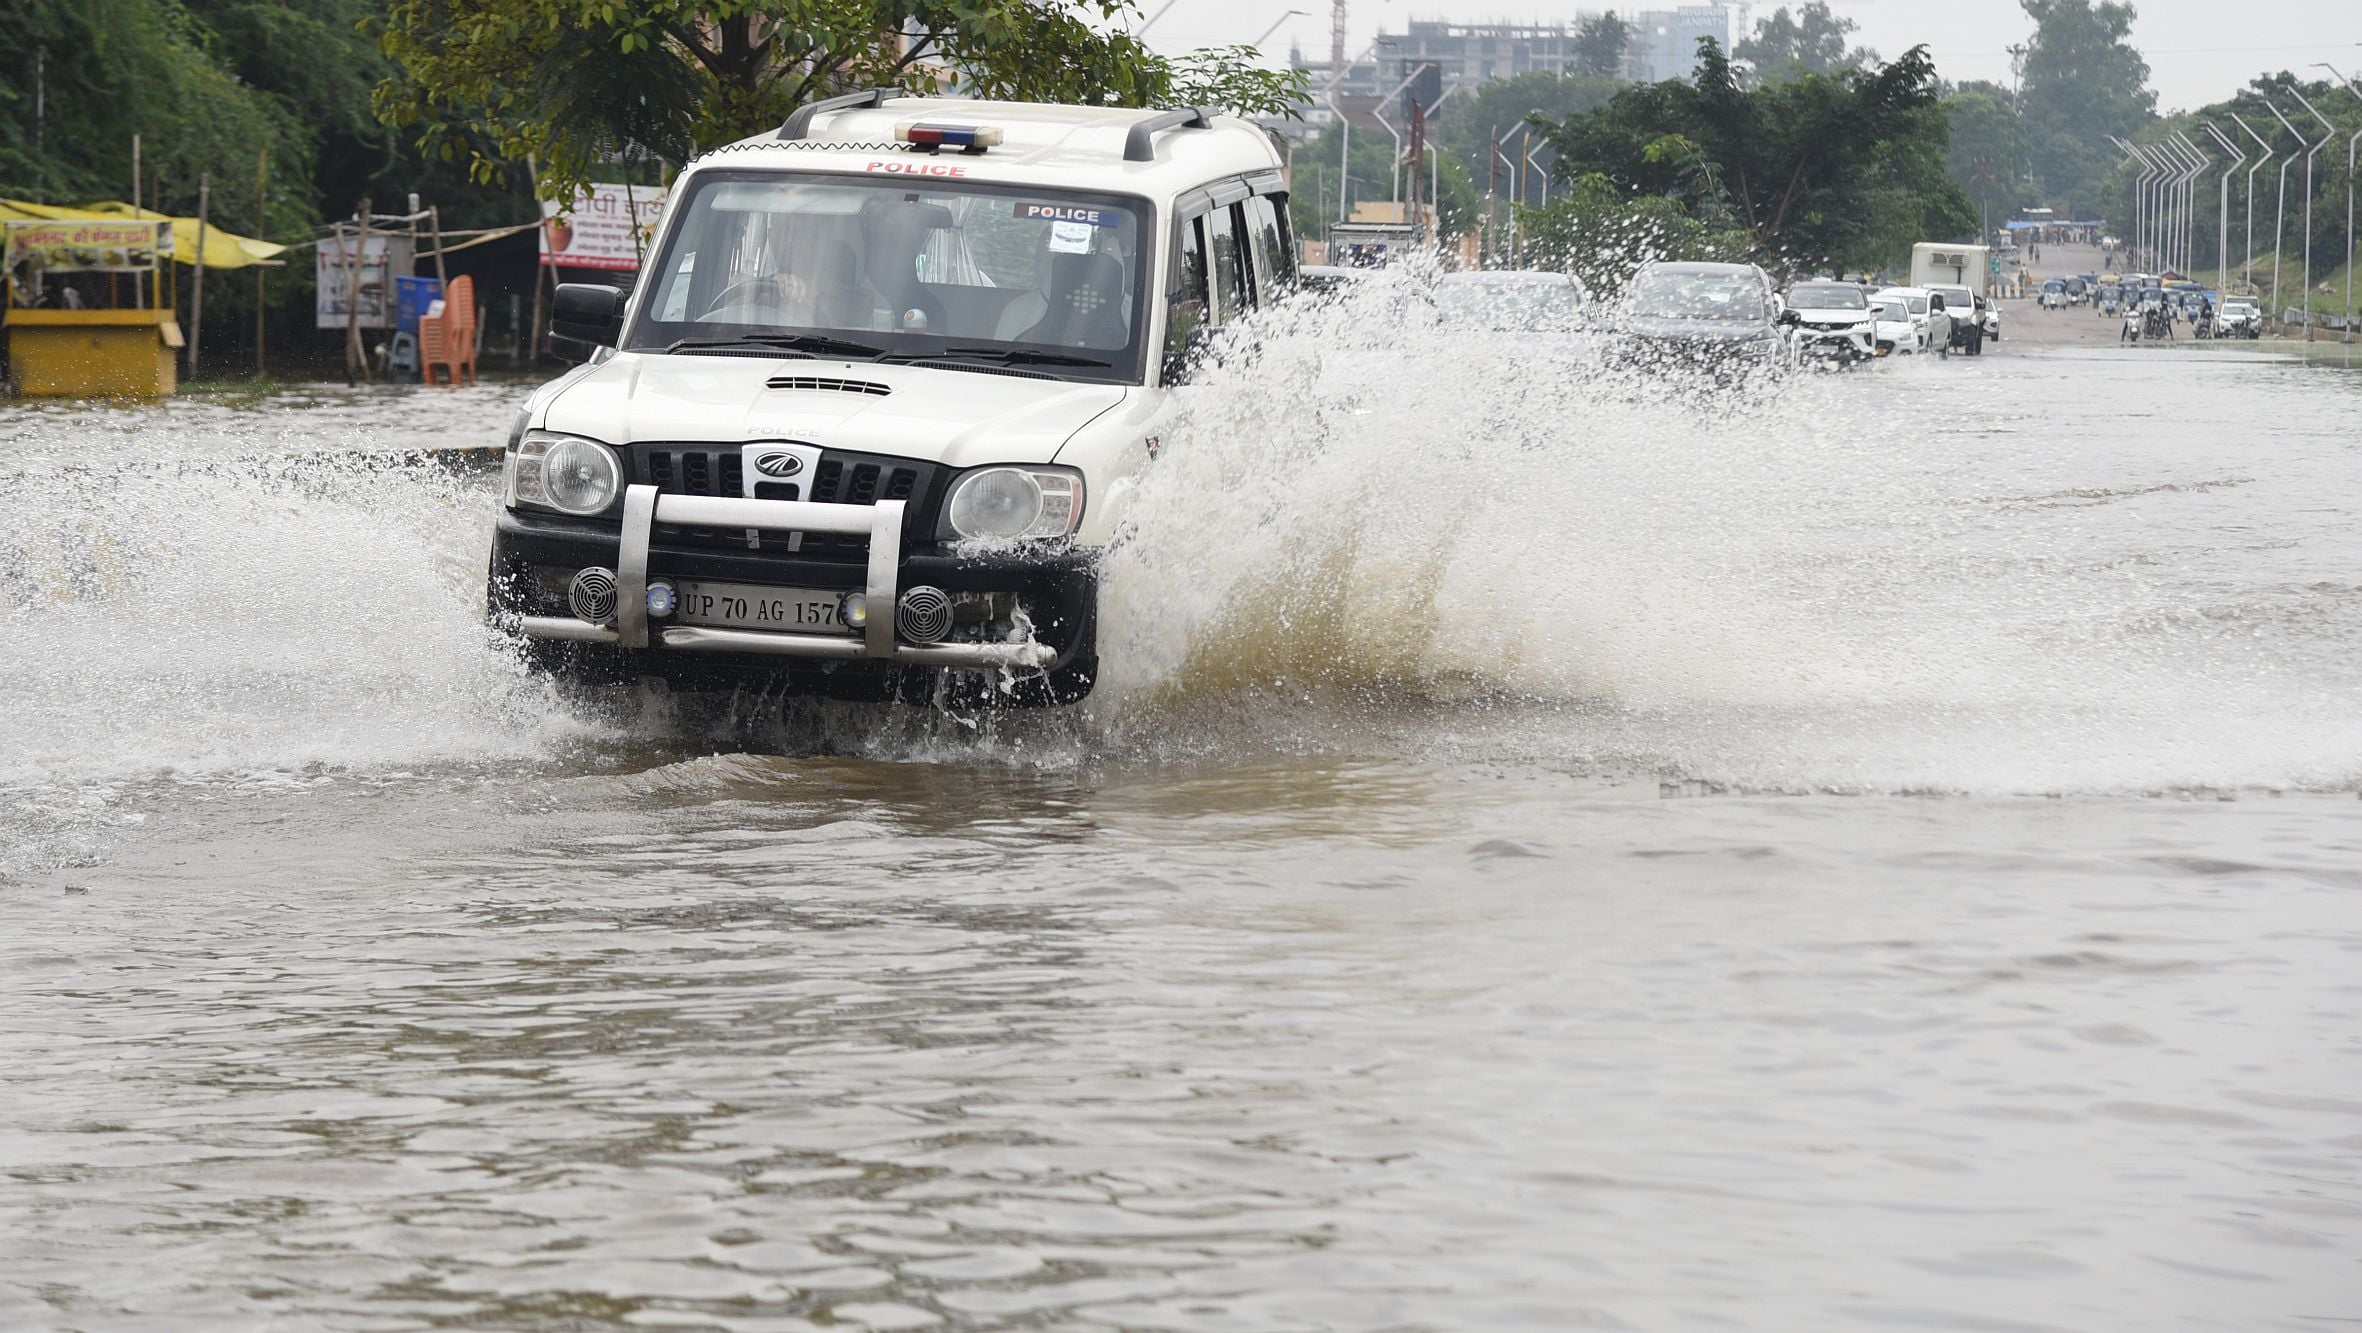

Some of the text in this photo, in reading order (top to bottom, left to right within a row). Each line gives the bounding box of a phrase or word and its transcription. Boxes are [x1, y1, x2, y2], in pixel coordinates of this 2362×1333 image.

[866, 161, 966, 177] POLICE
[1027, 205, 1100, 223] POLICE
[747, 426, 819, 437] POLICE
[686, 593, 714, 617] UP
[722, 597, 747, 619] 70
[757, 599, 784, 621] AG
